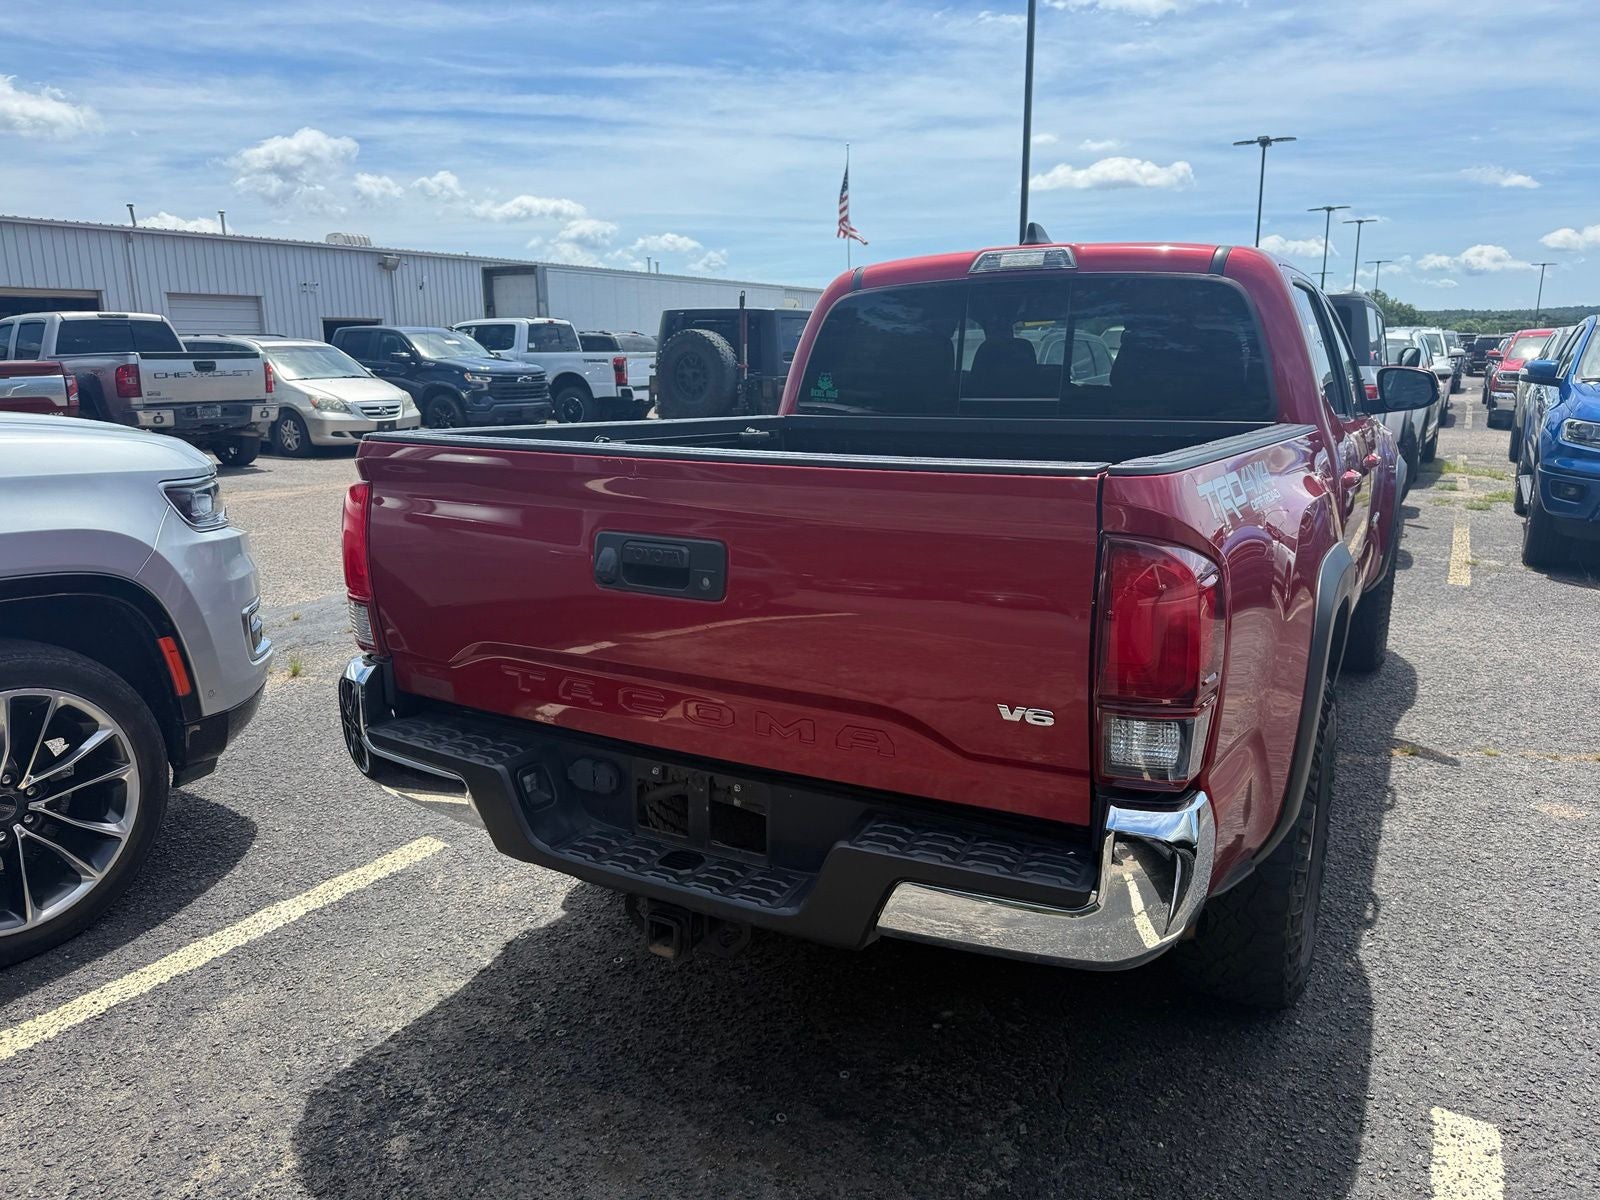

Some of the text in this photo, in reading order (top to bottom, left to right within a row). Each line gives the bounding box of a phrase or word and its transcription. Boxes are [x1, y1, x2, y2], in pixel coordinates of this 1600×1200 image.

[154, 369, 253, 379] CHEVROLET
[1196, 471, 1248, 528] TRD
[625, 545, 682, 565] TOYOTA
[500, 664, 897, 758] TACOMA
[996, 703, 1055, 727] V6
